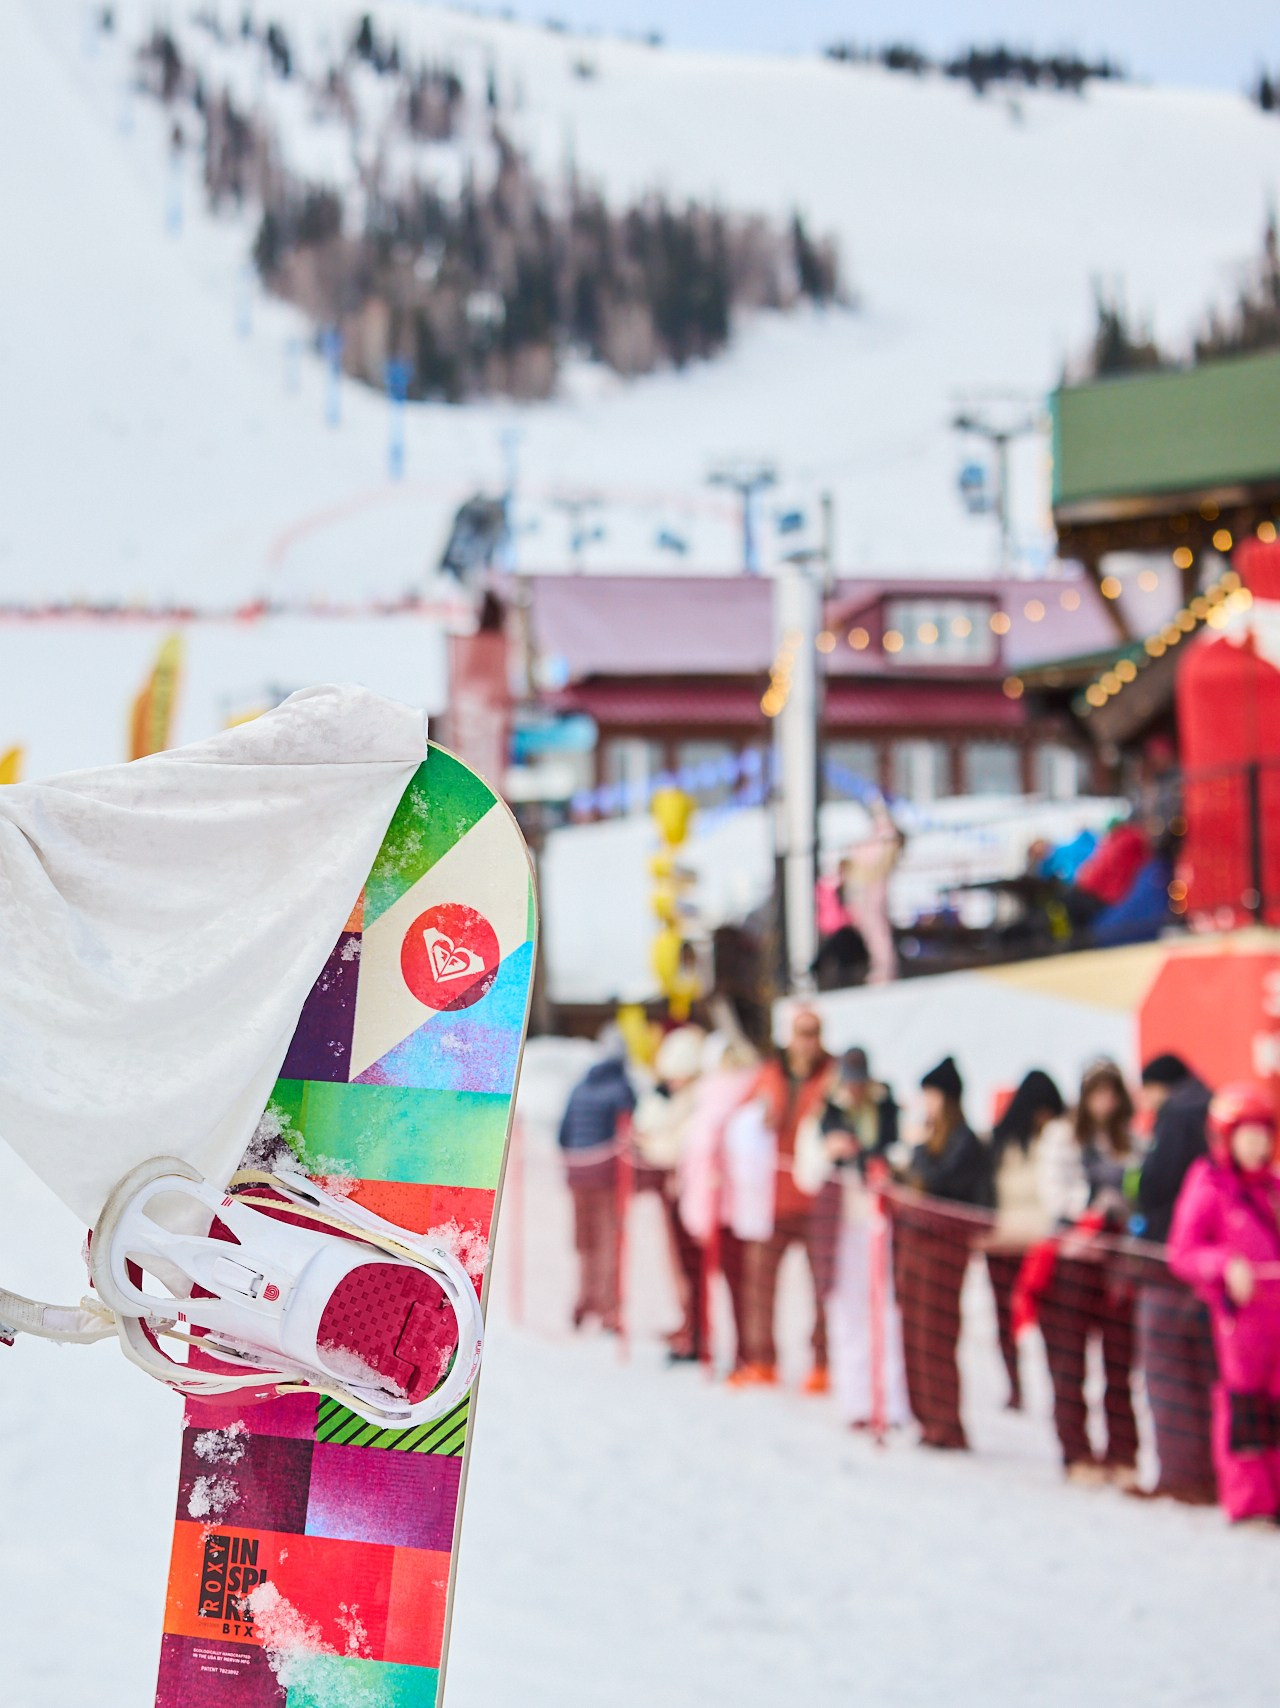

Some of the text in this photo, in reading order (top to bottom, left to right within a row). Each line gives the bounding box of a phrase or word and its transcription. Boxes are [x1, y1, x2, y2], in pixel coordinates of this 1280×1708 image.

[231, 1537, 259, 1566] IN
[203, 1541, 226, 1612] ROXY
[222, 1623, 253, 1638] BTX
[222, 1651, 251, 1659] HANDCRAFTED
